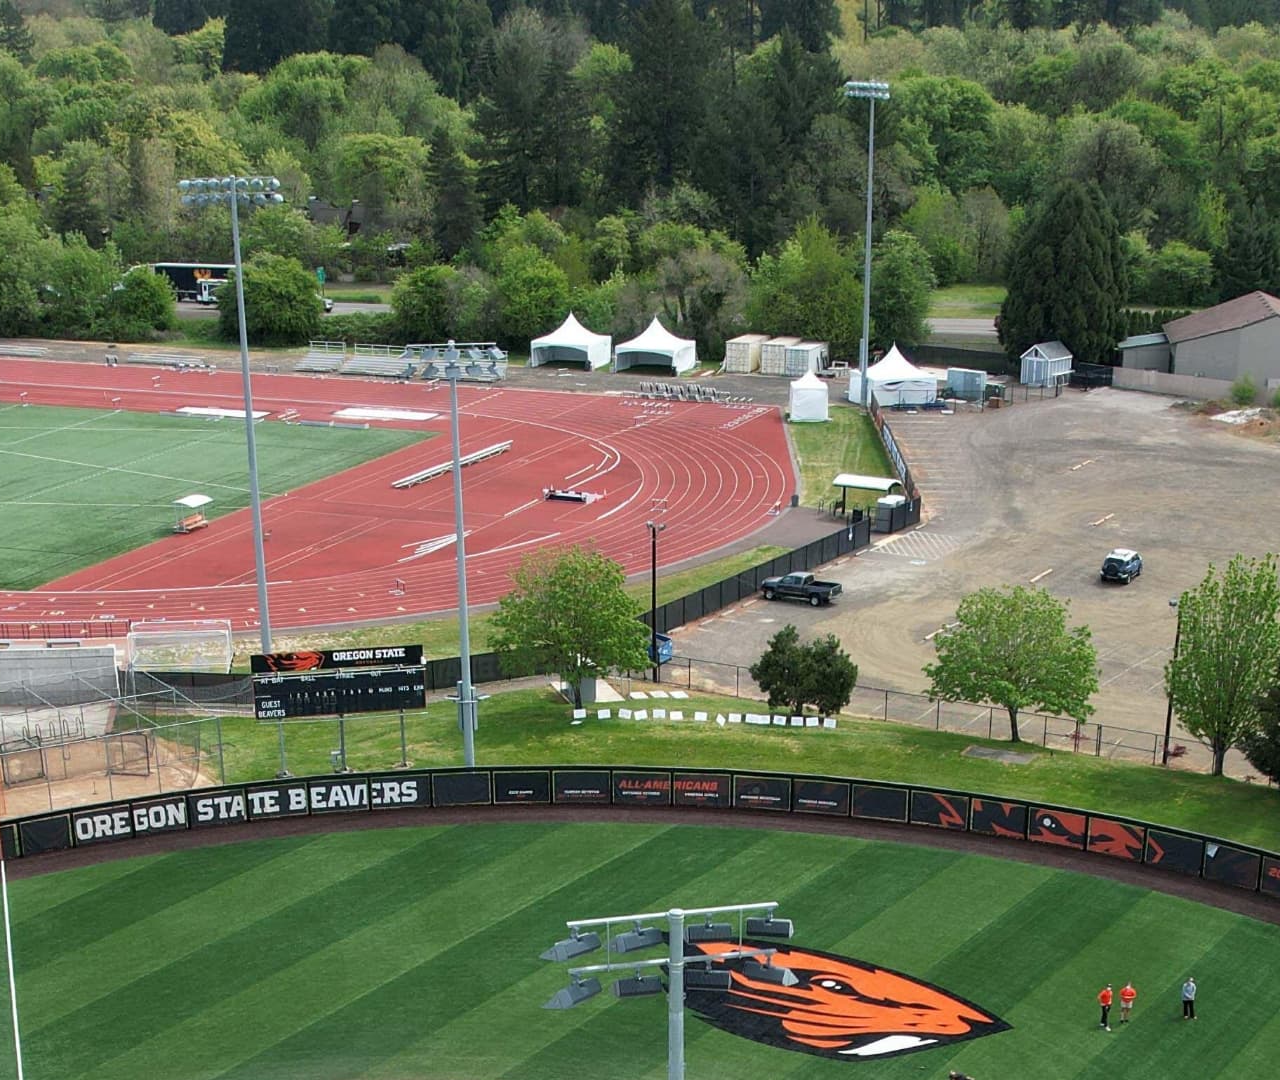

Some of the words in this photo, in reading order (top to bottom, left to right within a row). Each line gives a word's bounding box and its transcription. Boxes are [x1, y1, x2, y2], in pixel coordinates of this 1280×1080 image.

[332, 649, 373, 662] OREGON
[375, 647, 406, 659] STATE
[261, 700, 281, 708] GUEST
[258, 709, 286, 718] BEAVERS
[618, 778, 719, 792] ALL-AMERICANS
[76, 802, 187, 841] OREGON
[197, 790, 280, 822] STATE
[288, 781, 419, 811] BEAVERS
